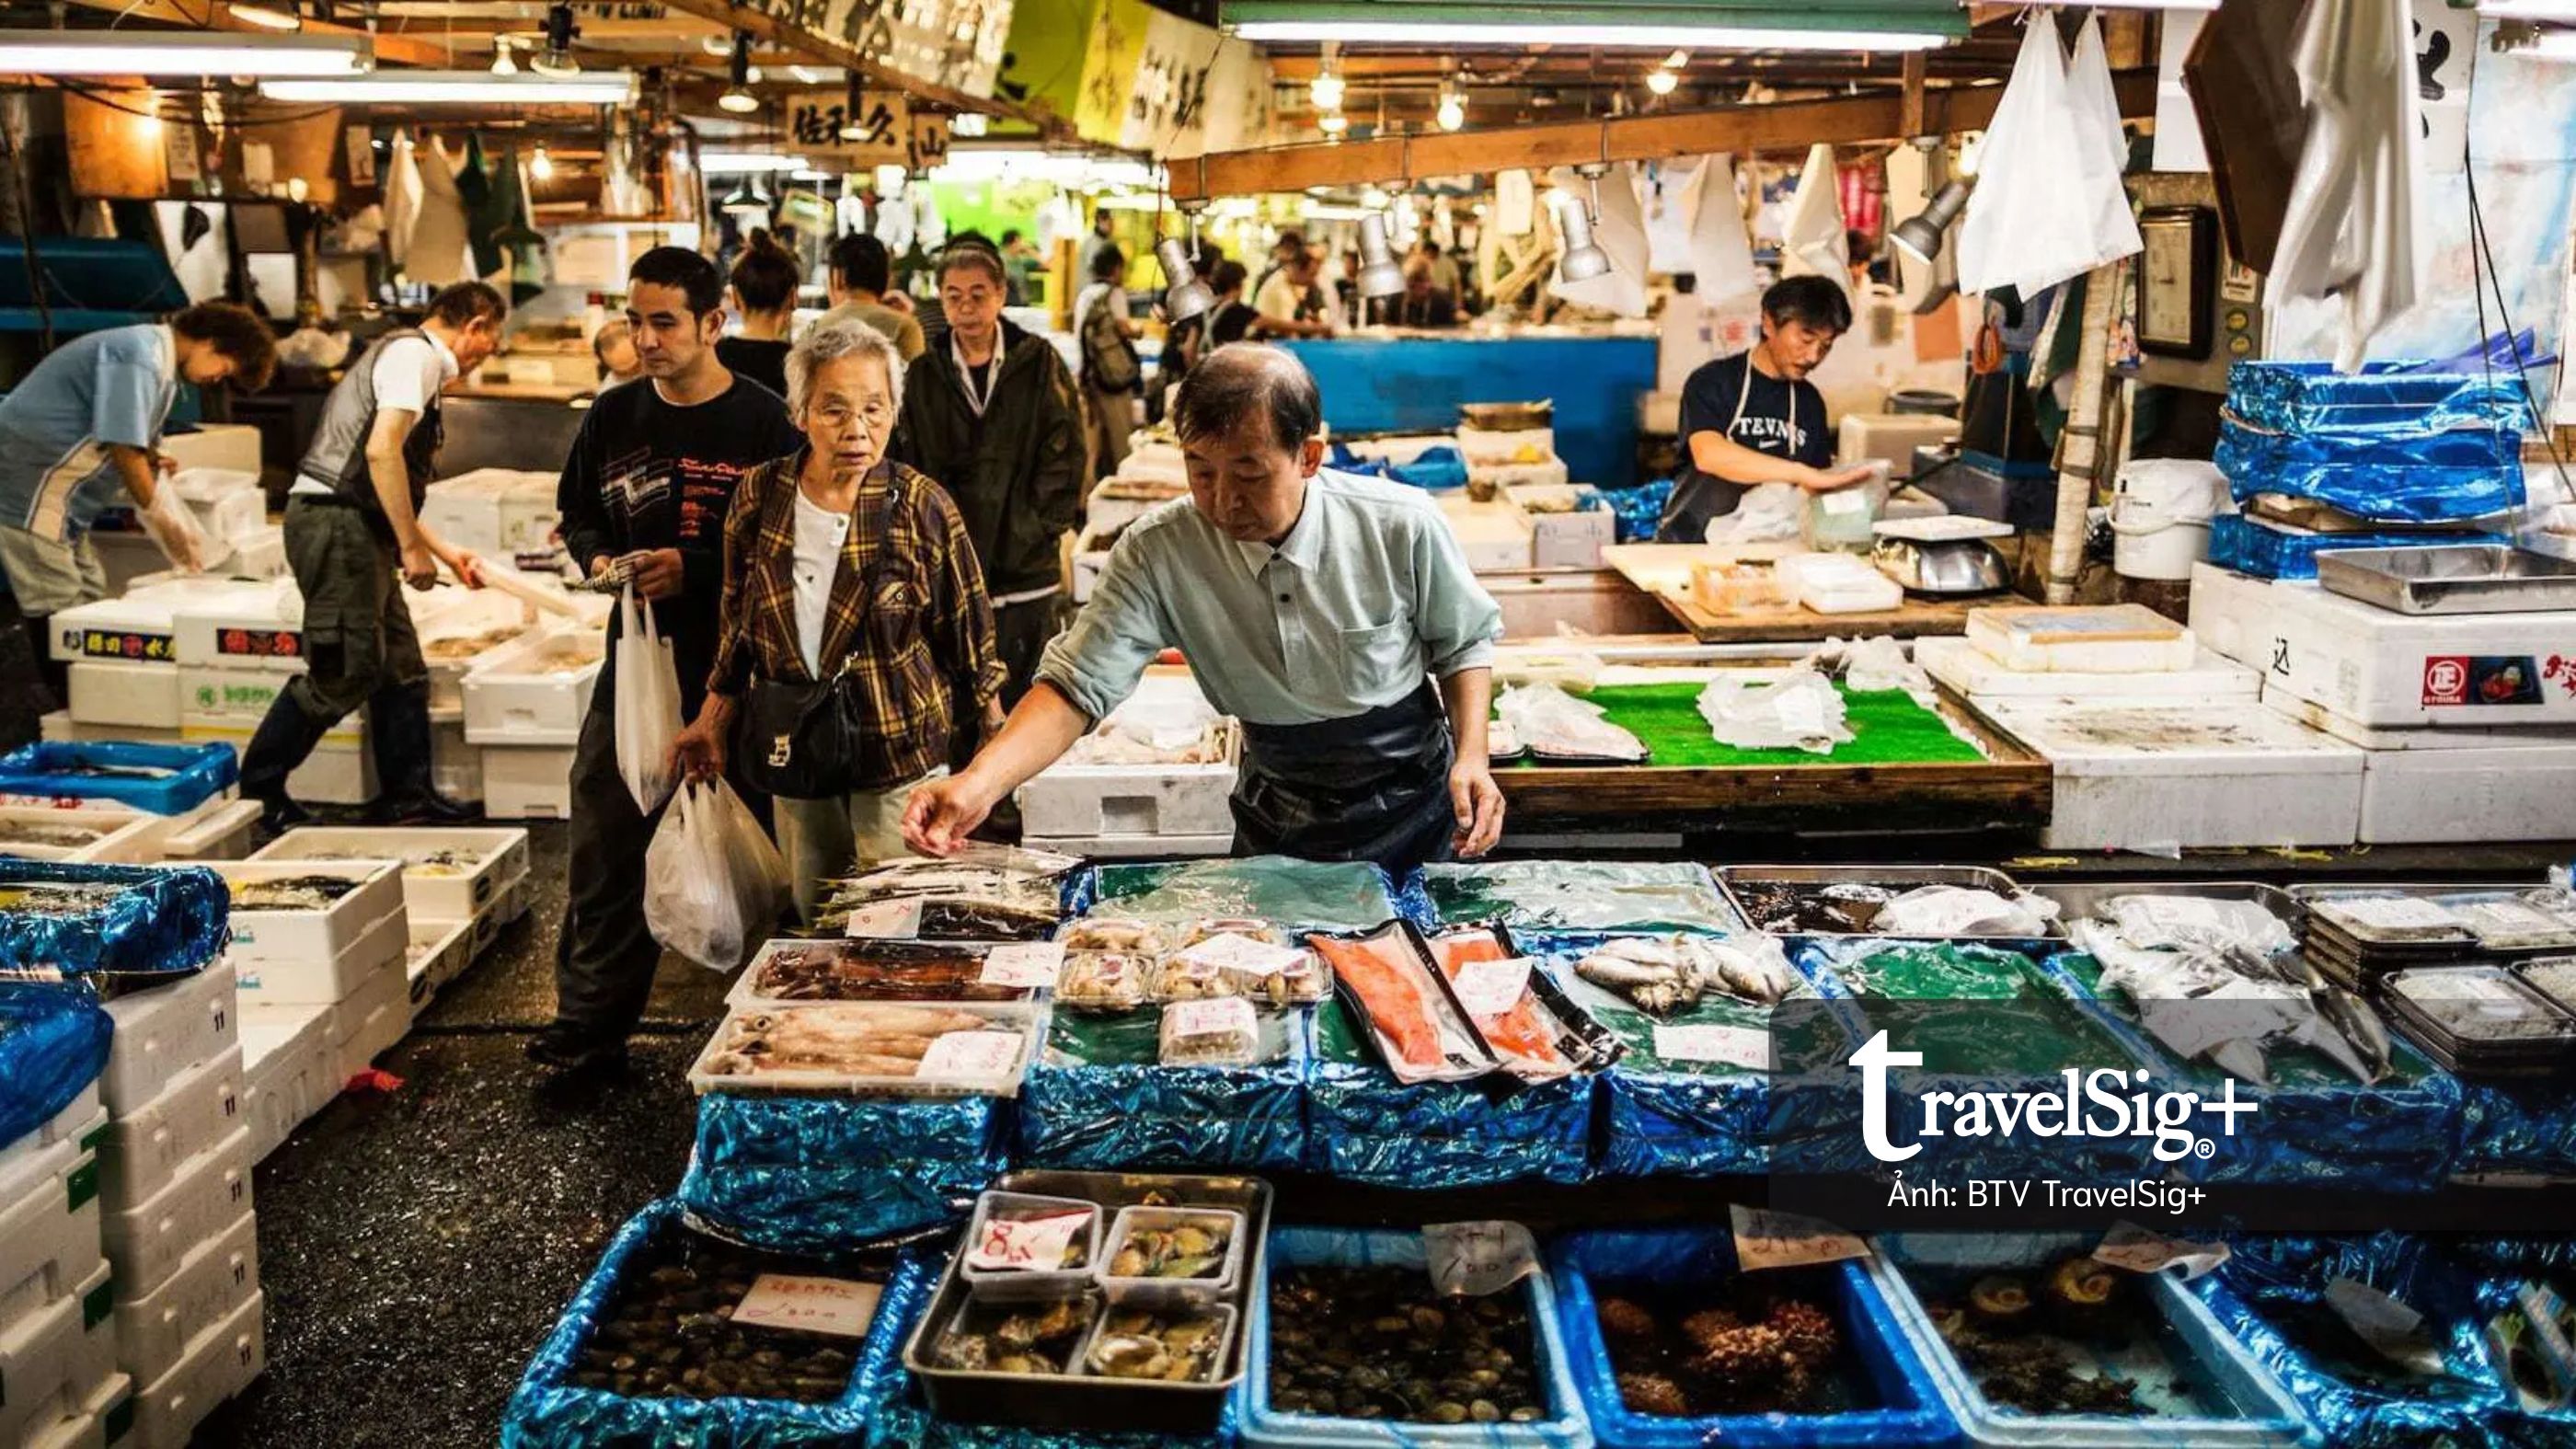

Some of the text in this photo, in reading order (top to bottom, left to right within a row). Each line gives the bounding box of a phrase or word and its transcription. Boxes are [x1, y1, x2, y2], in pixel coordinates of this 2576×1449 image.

[1739, 417, 1807, 447] TENNS
[214, 1010, 224, 1031] 11
[224, 1094, 236, 1117] 11
[230, 1179, 243, 1202] 11
[233, 1262, 246, 1285] 11
[239, 1341, 251, 1366] 11
